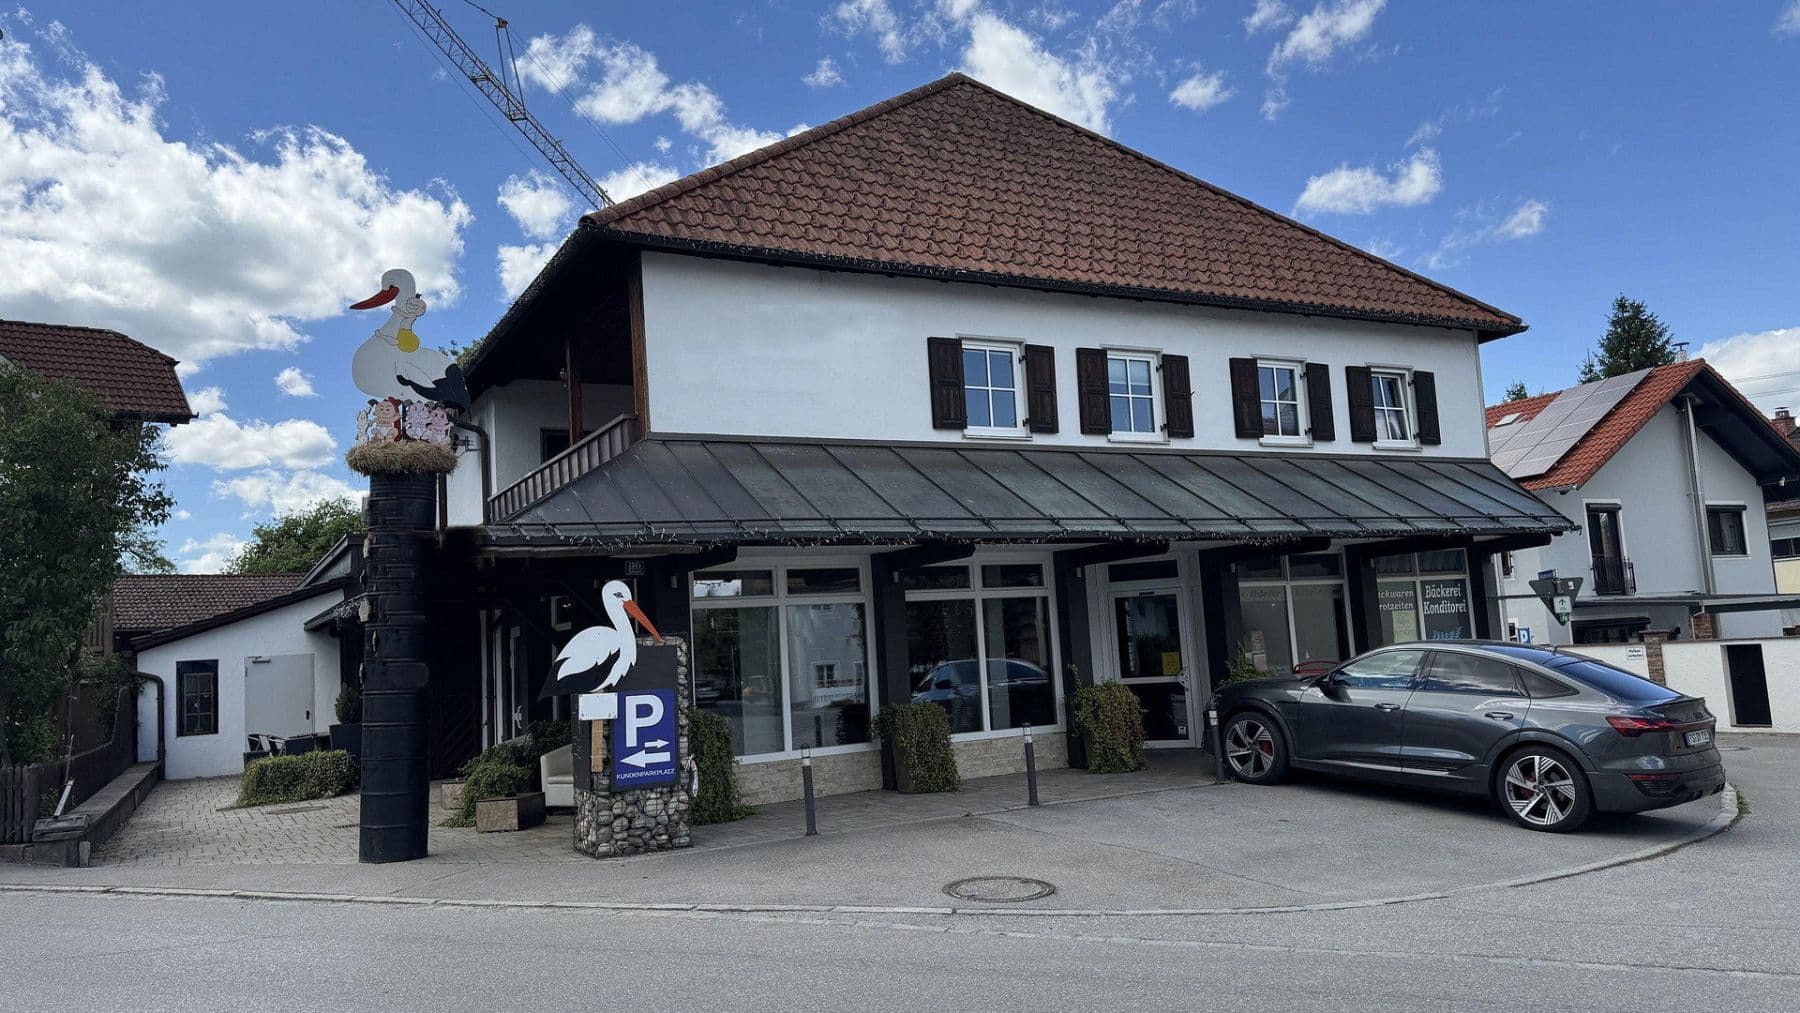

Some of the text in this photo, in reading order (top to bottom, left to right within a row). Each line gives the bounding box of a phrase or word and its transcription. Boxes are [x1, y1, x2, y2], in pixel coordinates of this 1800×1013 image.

[1425, 583, 1461, 598] Bäckerei
[1379, 601, 1414, 611] rotzeiten
[1423, 599, 1467, 615] Konditorei
[625, 694, 664, 748] P
[616, 767, 675, 781] KUNDENPARKPLATZ
